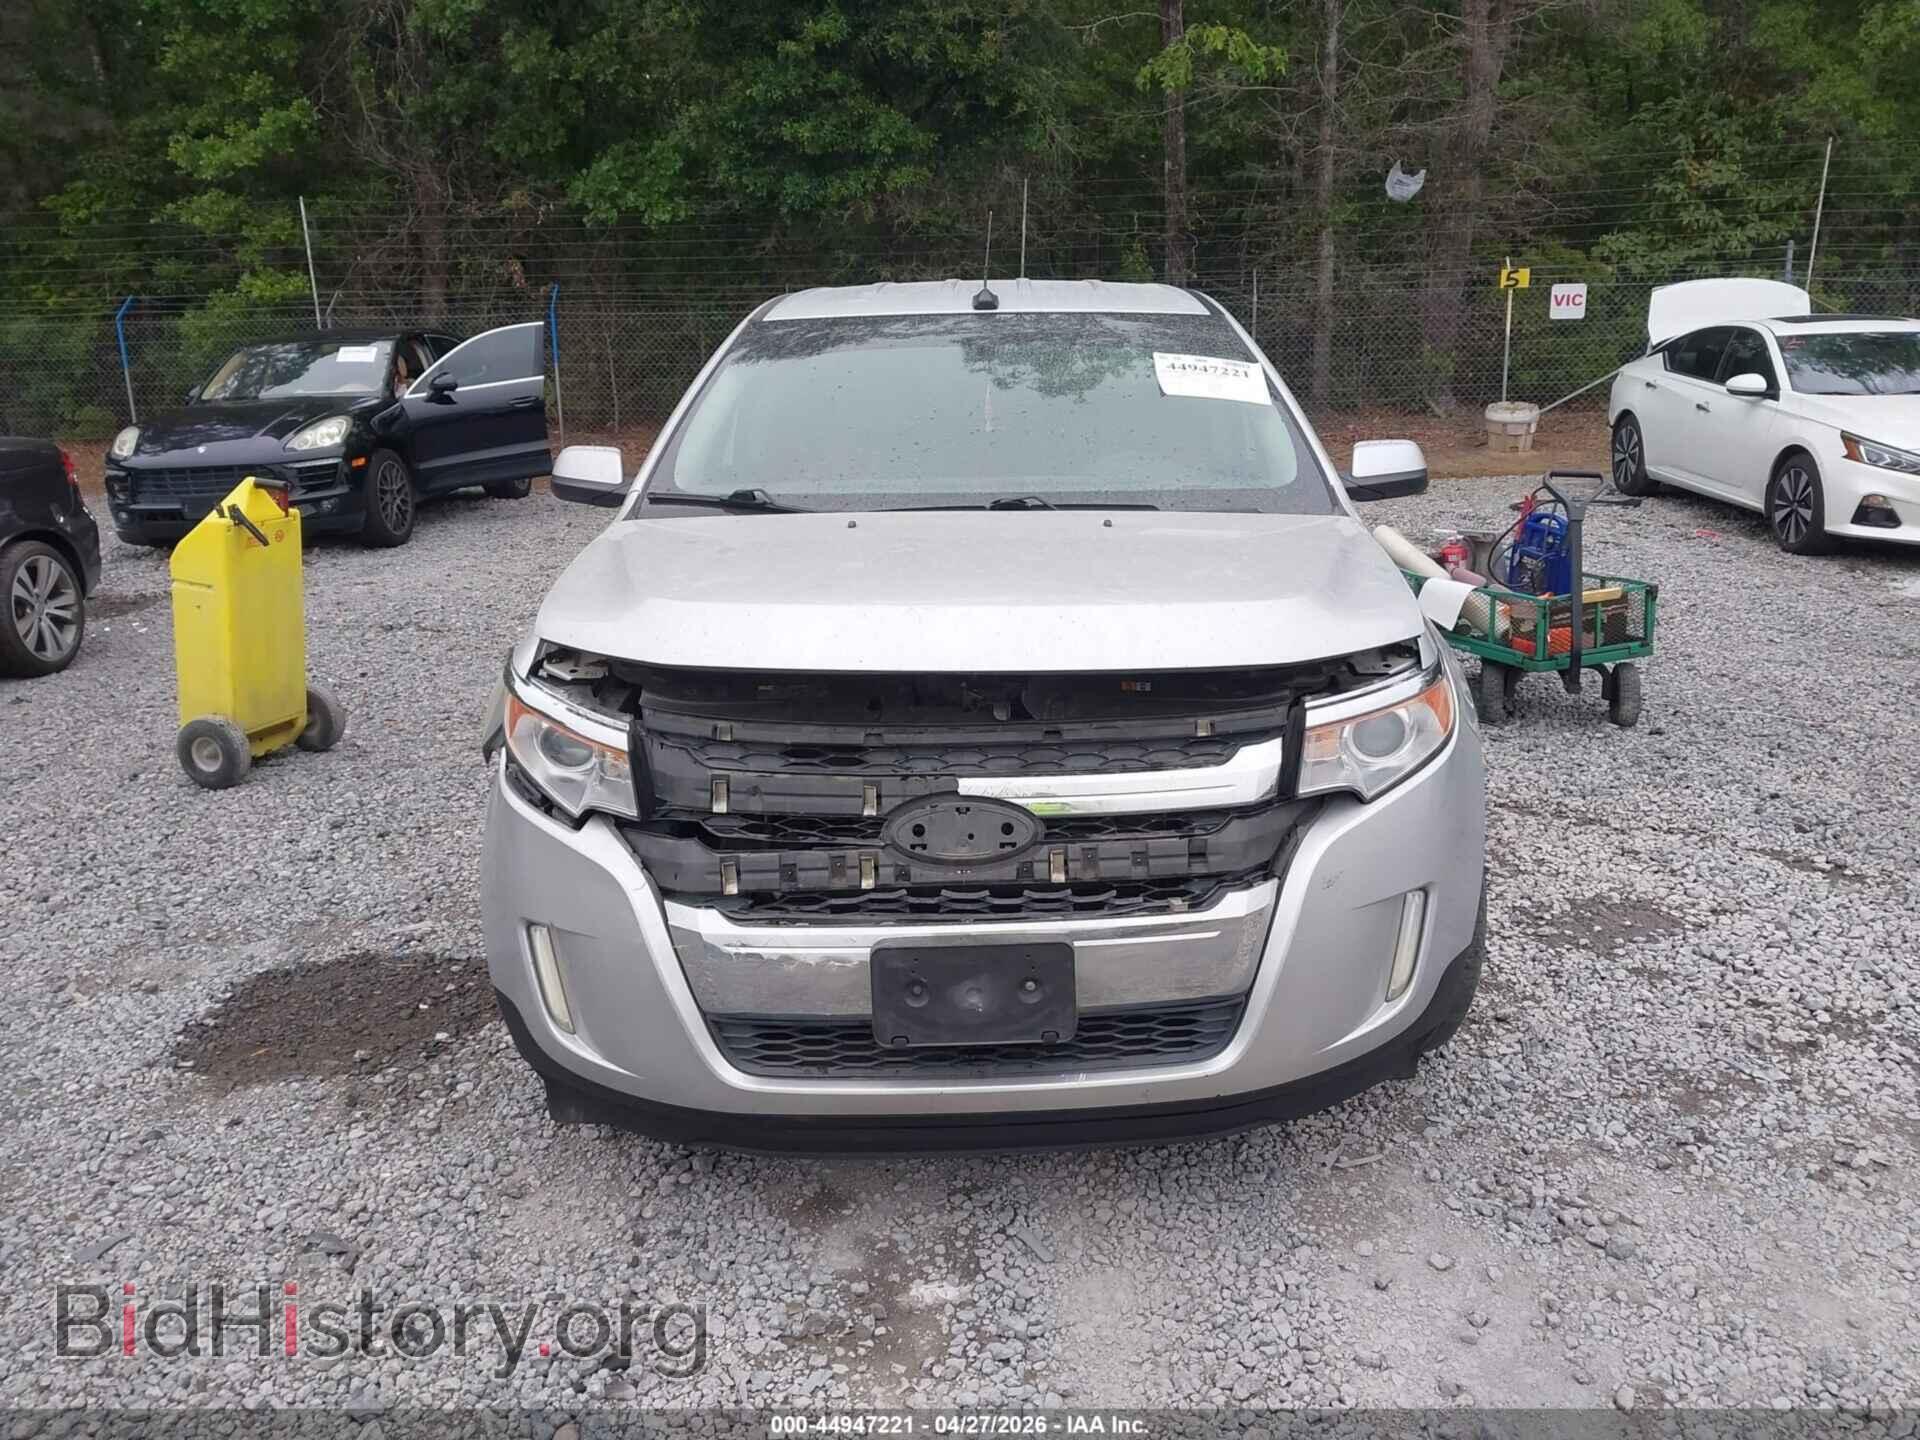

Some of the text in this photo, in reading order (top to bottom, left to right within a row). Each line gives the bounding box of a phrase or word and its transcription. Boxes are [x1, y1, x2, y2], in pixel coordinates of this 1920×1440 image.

[1504, 270, 1519, 287] 5
[1554, 294, 1583, 306] VIC
[1166, 362, 1249, 378] 44947221
